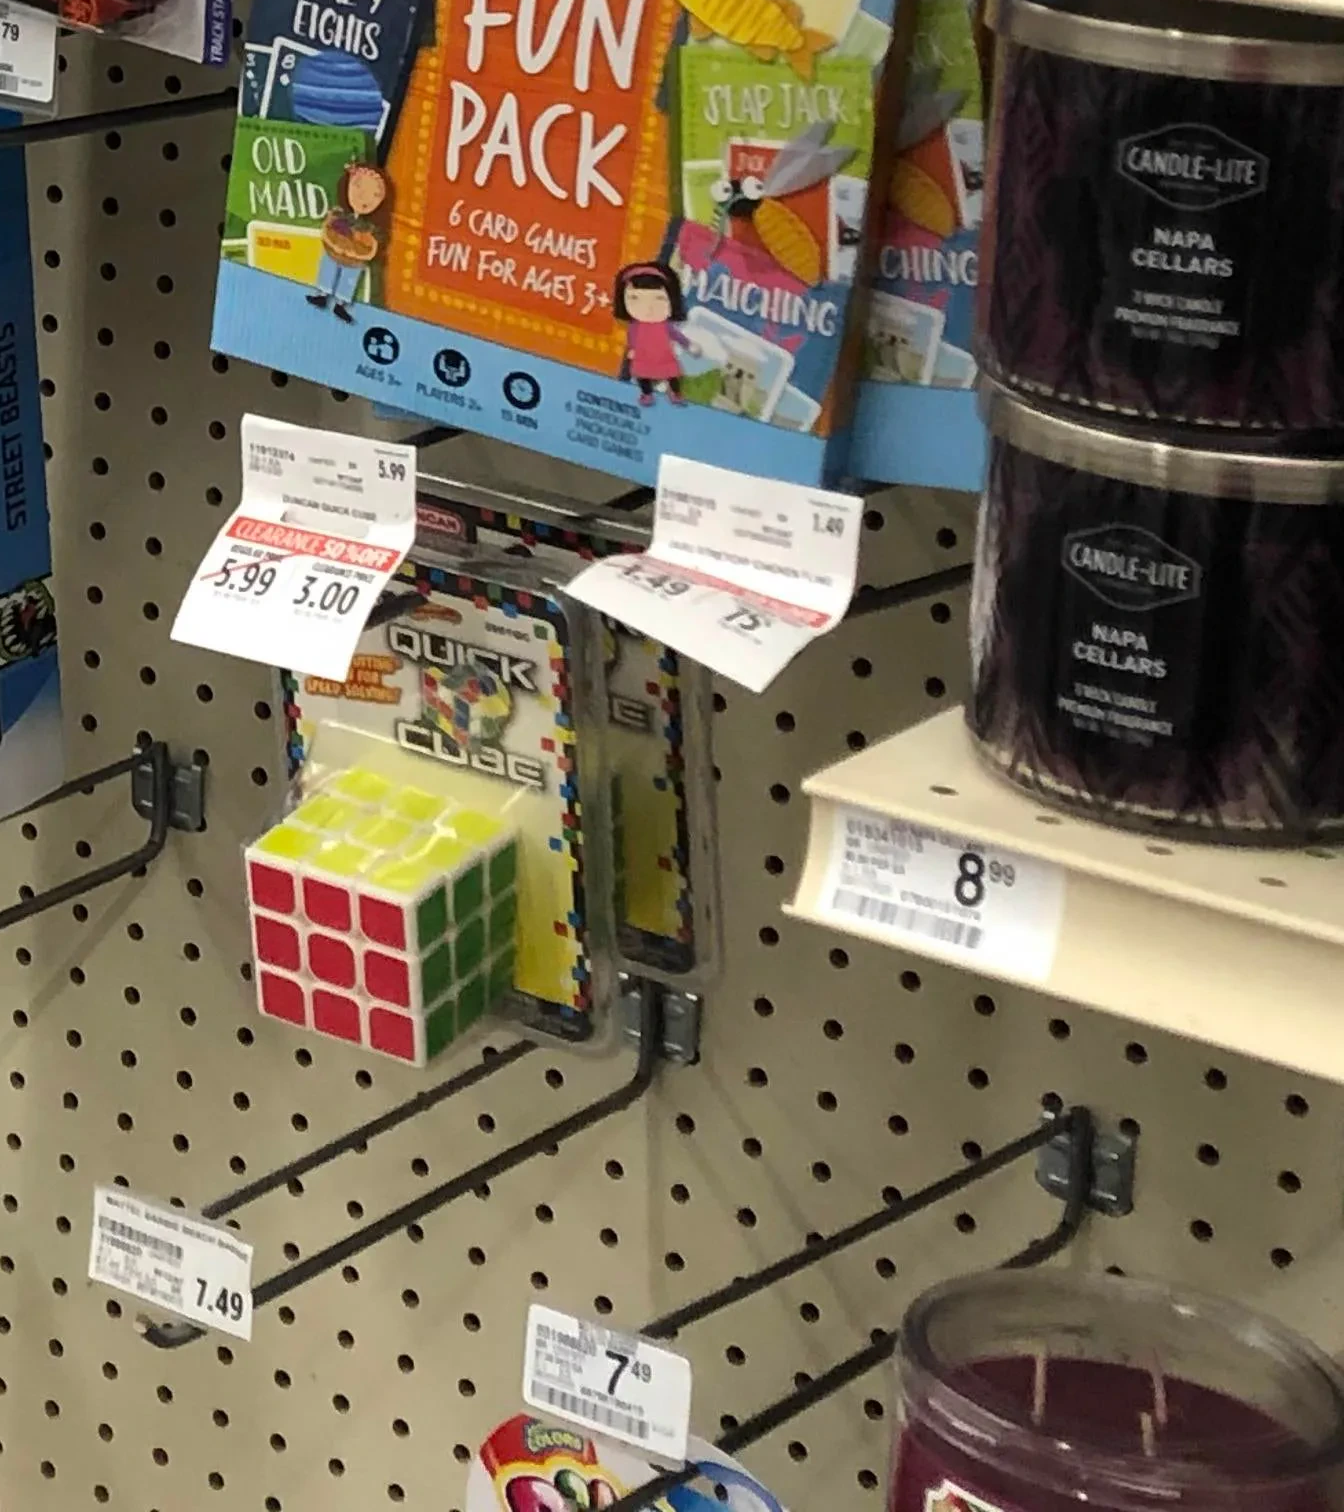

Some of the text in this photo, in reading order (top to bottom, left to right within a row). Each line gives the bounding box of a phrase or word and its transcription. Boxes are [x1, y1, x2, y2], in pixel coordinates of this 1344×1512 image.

[704, 84, 850, 129] SLAP JACK
[251, 137, 306, 175] OLD
[446, 79, 625, 209] PACK
[1126, 147, 1256, 185] CANDLE-LITE
[249, 179, 329, 223] MAID
[449, 201, 598, 268] 6 CARD GAMES
[1154, 228, 1215, 251] NAPA
[427, 235, 613, 318] FUN FOR AGES 3+
[1132, 248, 1234, 278] CELLARS
[2, 433, 27, 530] STREET
[378, 459, 406, 481] 5.99
[235, 520, 320, 554] CLEARANCE
[214, 558, 360, 615] 5.99 3.00
[1069, 541, 1190, 589] CANDLE-LITE
[389, 629, 537, 690] QUICK
[1092, 622, 1149, 653] NAPA
[1073, 643, 1168, 679] CELLARS
[399, 723, 542, 788] CUBE
[197, 1278, 243, 1321] 7.49
